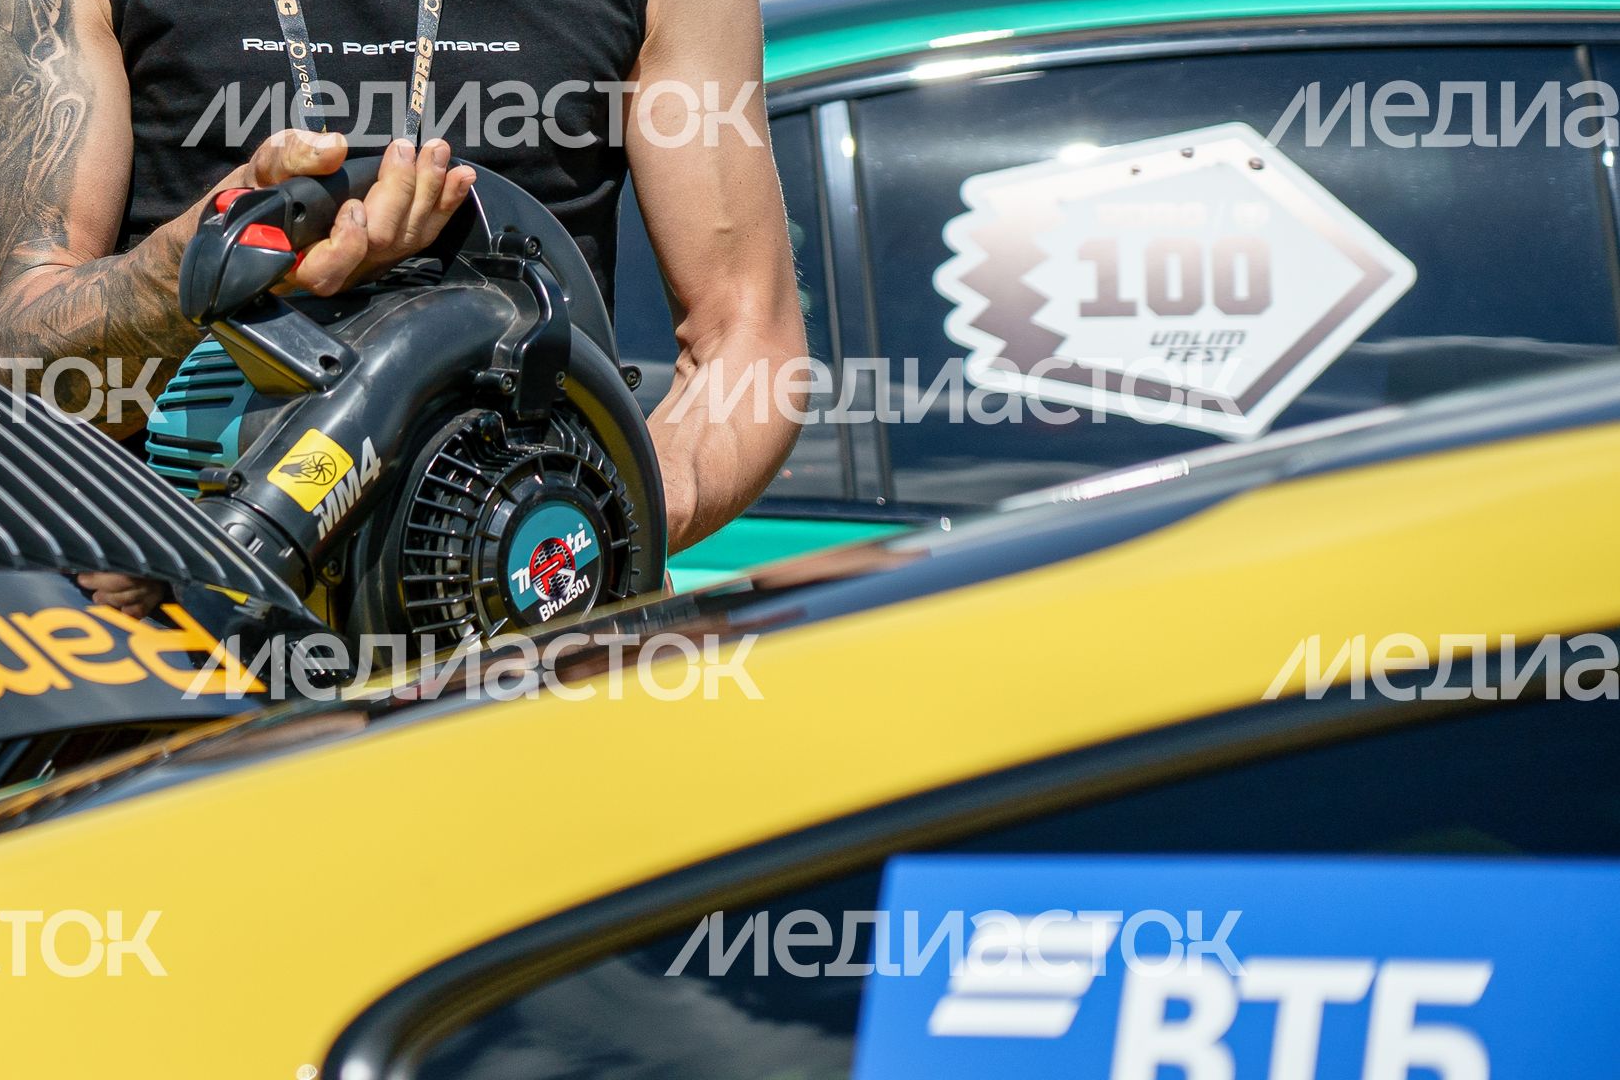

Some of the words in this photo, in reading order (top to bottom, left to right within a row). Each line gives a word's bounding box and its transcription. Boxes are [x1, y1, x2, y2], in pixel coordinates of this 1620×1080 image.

[342, 39, 521, 56] Perfomance
[292, 62, 314, 109] years
[1077, 237, 1272, 318] 100
